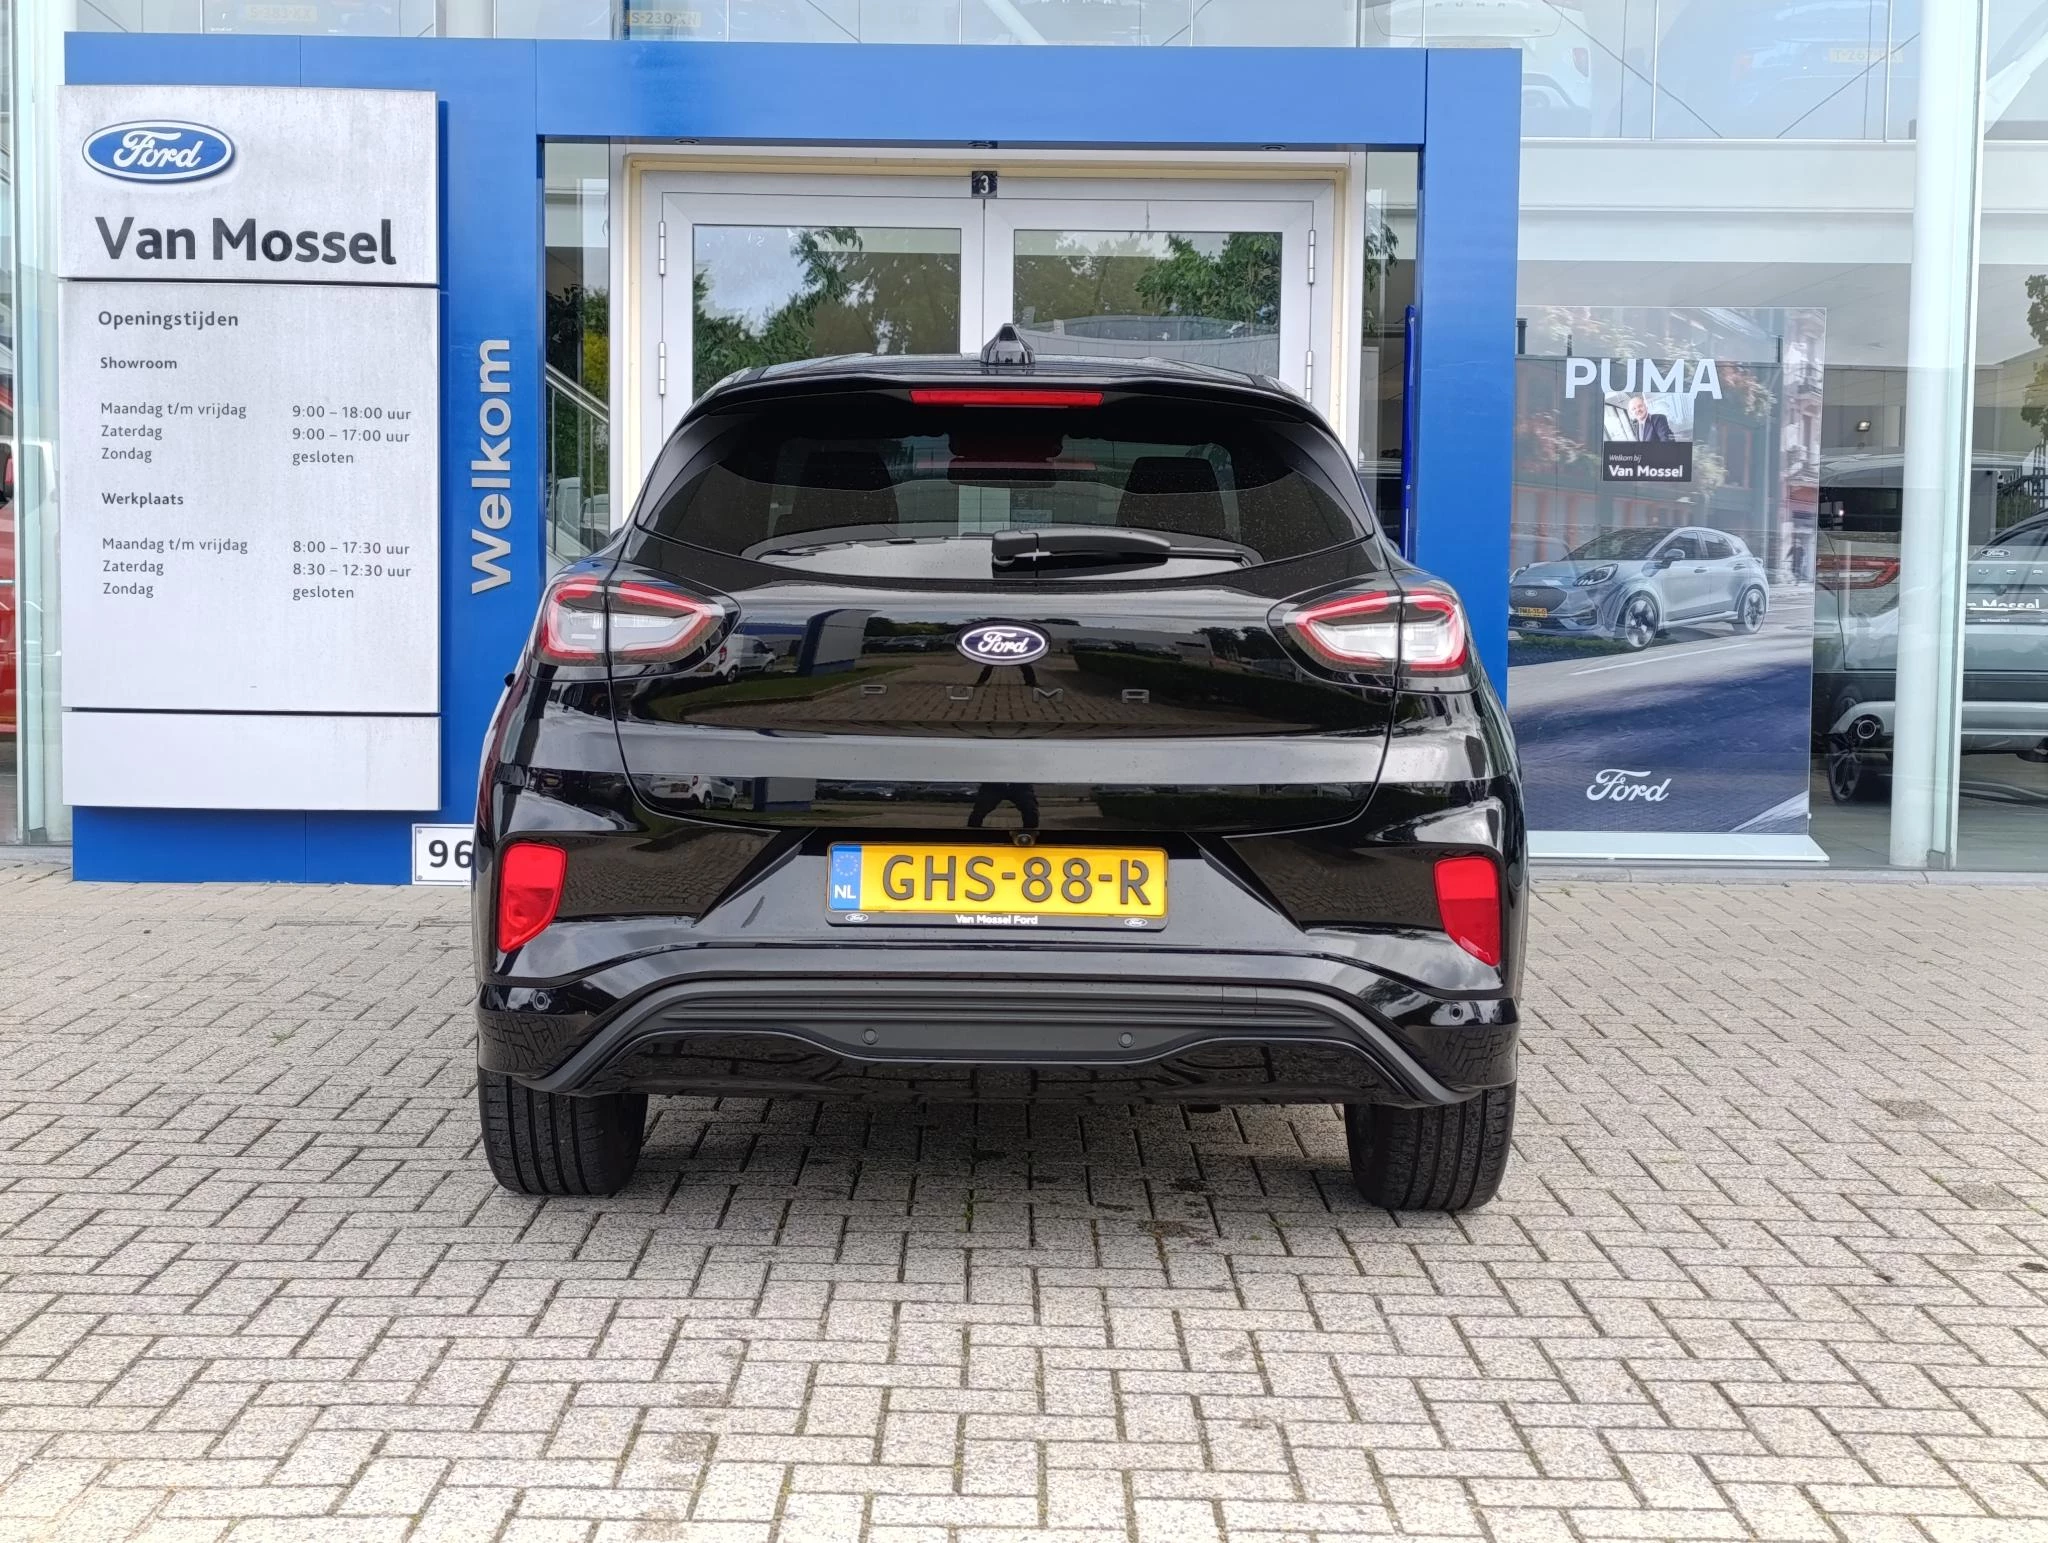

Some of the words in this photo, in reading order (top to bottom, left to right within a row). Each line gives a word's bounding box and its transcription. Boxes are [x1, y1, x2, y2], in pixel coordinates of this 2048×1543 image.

[112, 130, 204, 170] Ford
[980, 175, 990, 194] 3
[95, 216, 196, 260] Van
[212, 217, 397, 266] Mossel
[98, 310, 239, 331] Openingstijden
[100, 356, 178, 370] Showroom
[1565, 357, 1724, 400] PUMA
[101, 402, 163, 419] Maandag
[168, 402, 194, 416] t/m
[198, 402, 247, 420] vrijdag
[292, 405, 325, 418] 9:00
[342, 406, 383, 420] 18:00
[387, 410, 412, 420] uur
[101, 424, 163, 441] Zaterdag
[292, 428, 325, 441] 9:00
[342, 429, 381, 442] 17:00
[386, 432, 410, 443] uur
[101, 447, 153, 464] Zondag
[292, 451, 354, 466] gesloten
[1609, 454, 1633, 462] Welkom
[471, 339, 512, 595] Welkom
[1609, 465, 1634, 477] Van
[1637, 465, 1683, 477] Mossel
[102, 492, 184, 509] Werkplaats
[103, 537, 165, 554] Maandag
[169, 537, 195, 551] t/m
[199, 537, 248, 555] vrijdag
[292, 540, 326, 553] 8:00
[342, 541, 382, 555] 17:30
[386, 545, 410, 555] uur
[103, 560, 164, 577] Zaterdag
[292, 563, 326, 576] 8:30
[342, 563, 383, 577] 12:30
[387, 568, 412, 578] uur
[103, 582, 154, 599] Zondag
[292, 586, 354, 601] gesloten
[977, 630, 1028, 653] Ford
[1586, 768, 1672, 802] Ford
[428, 839, 472, 869] 96
[882, 854, 1151, 905] GHS-88-R
[834, 884, 857, 899] NL
[954, 914, 975, 924] Van
[976, 914, 1012, 925] Mossel
[1013, 915, 1039, 925] Ford
